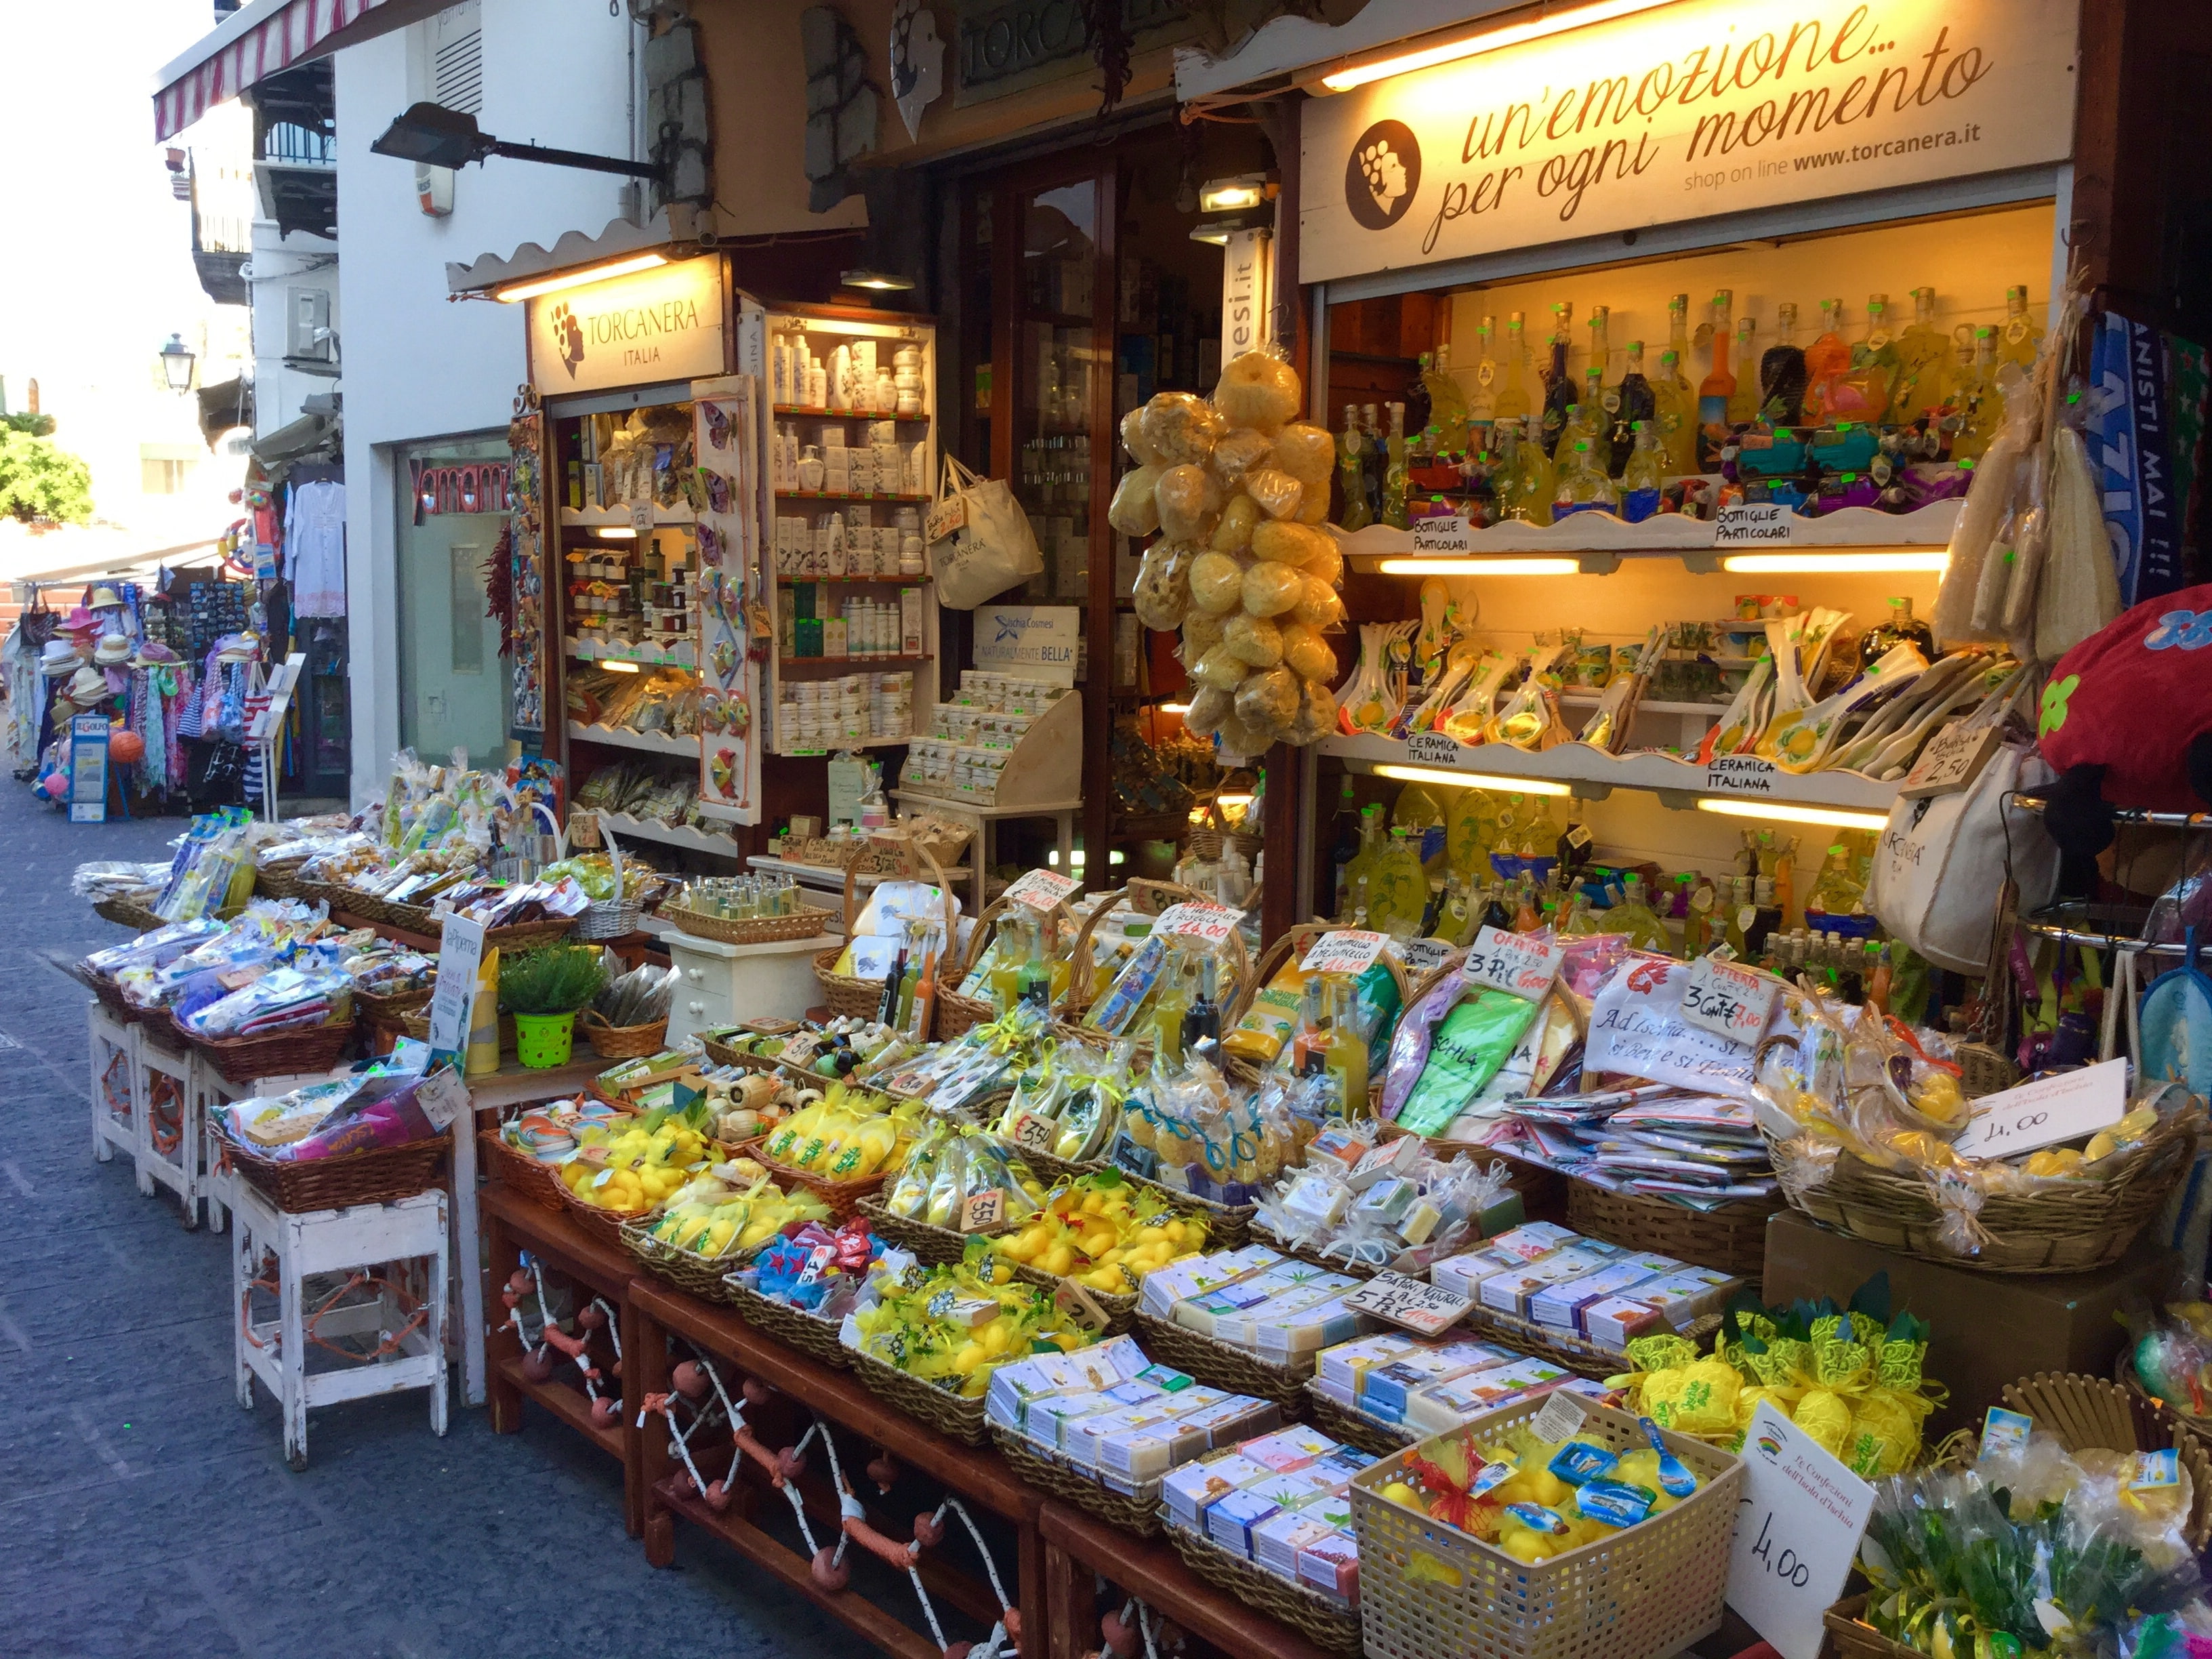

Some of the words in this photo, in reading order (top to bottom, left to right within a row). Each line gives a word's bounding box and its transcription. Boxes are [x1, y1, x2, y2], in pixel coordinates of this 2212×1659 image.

[1422, 161, 1523, 255] per
[1536, 115, 1659, 222] ogni
[1685, 26, 1994, 162] momento
[1684, 169, 1725, 192] shop
[1731, 164, 1753, 184] on
[1757, 157, 1788, 180] line
[1793, 123, 1981, 172] www.torcanera.it
[588, 298, 699, 345] TORCANERA
[624, 346, 661, 367] ITALIA
[2143, 449, 2167, 519] MAI
[1717, 506, 1780, 523] BOTTIGLIE
[1415, 518, 1458, 533] BOTTIGLIE
[1716, 525, 1790, 541] PARTICOLARI
[1414, 535, 1468, 550] PARTICOLARI
[1026, 617, 1054, 629] Cosmesi
[982, 646, 1040, 661] NATURALMENTE
[1042, 646, 1071, 662] BELLA
[1408, 735, 1459, 752] CERAMICA
[1409, 750, 1456, 764] ITALIANA
[1707, 759, 1775, 773] CERAMICA
[1925, 758, 1970, 783] 2,50
[1708, 774, 1771, 792] ITALIANA
[1182, 902, 1228, 912] OFFERTA
[1177, 921, 1228, 938] 14,00
[1333, 929, 1380, 943] OFFERTA
[1323, 958, 1369, 972] 14,00
[1466, 953, 1486, 973] 3
[1712, 964, 1761, 991] OFFERTA
[1683, 985, 1703, 1008] 3
[1596, 1008, 1639, 1031] Ad
[1431, 1035, 1477, 1071] SCHIA
[1660, 1049, 1669, 1063] e
[1673, 1053, 1699, 1069] si
[1347, 1290, 1378, 1304] 5
[1415, 1285, 1467, 1307] NATURALI
[1805, 1462, 1855, 1509] Confezioni
[1819, 1496, 1854, 1530] d'Ischia
[1751, 1511, 1809, 1587] 4,00
